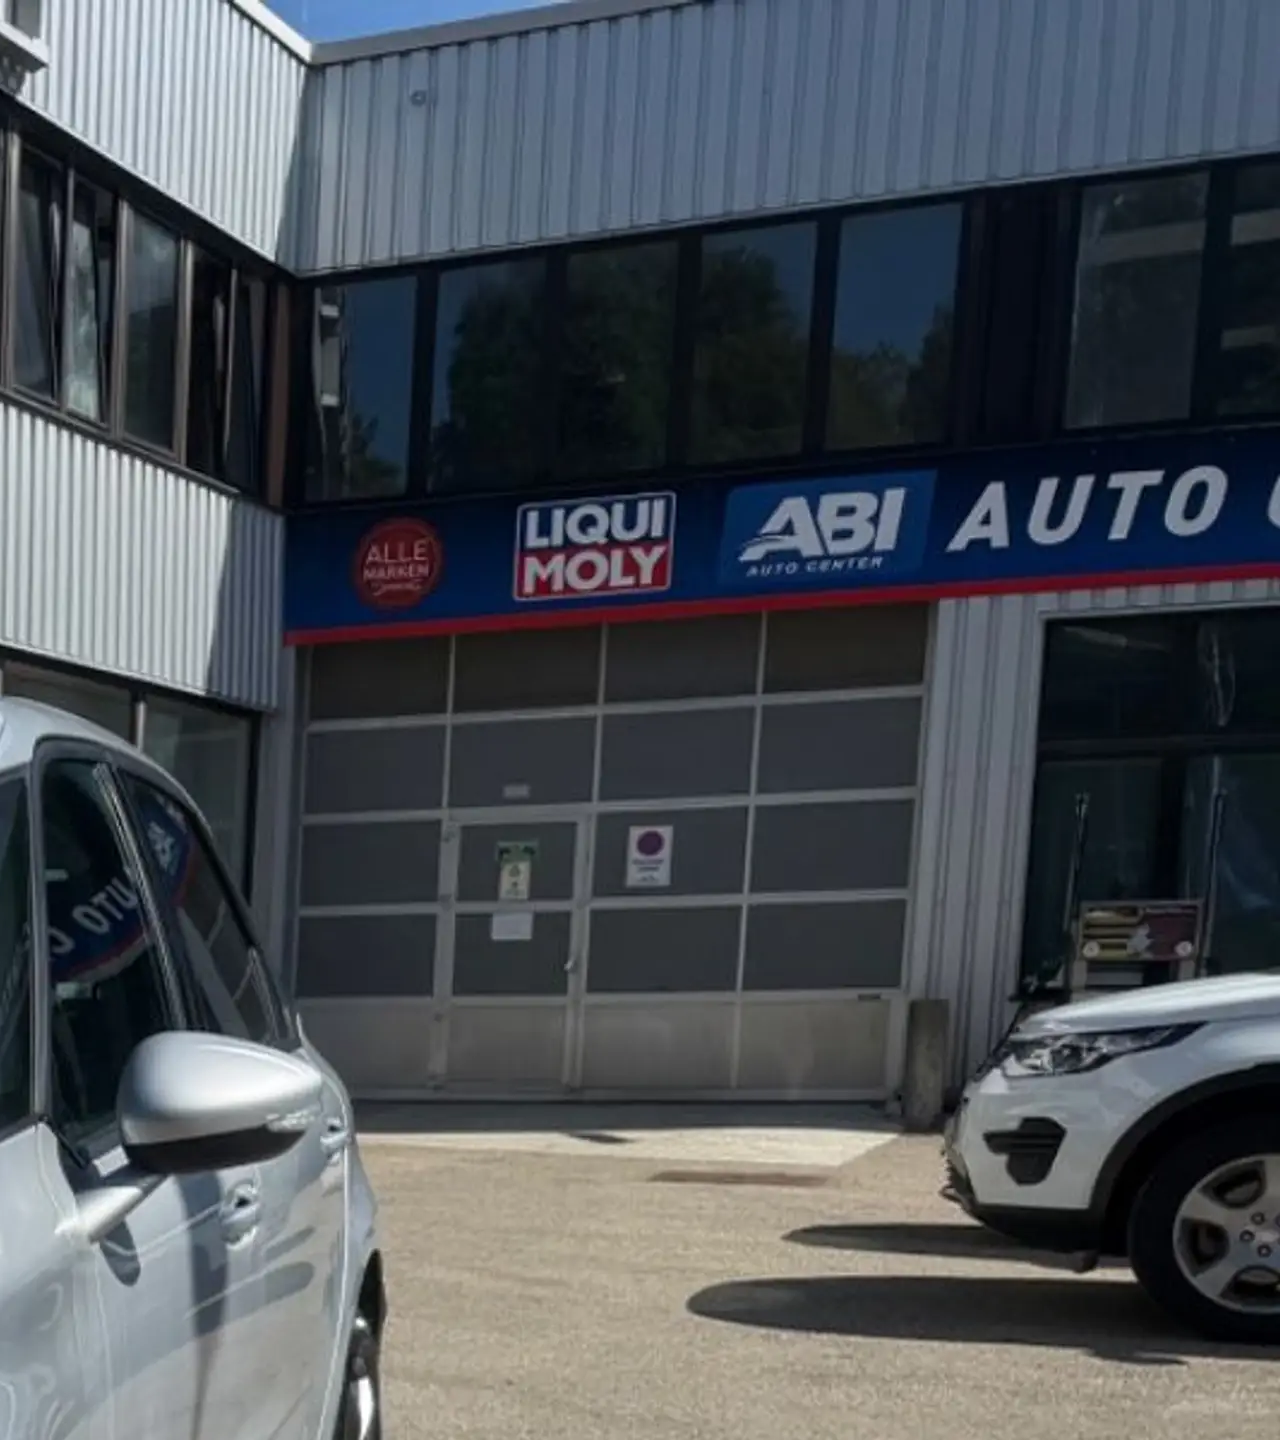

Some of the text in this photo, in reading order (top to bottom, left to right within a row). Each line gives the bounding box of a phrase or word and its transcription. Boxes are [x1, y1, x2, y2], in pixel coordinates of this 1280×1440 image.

[525, 499, 665, 549] LIQUI
[738, 487, 906, 562] ABI
[945, 465, 1228, 552] AUTO
[363, 563, 429, 581] MARKEN
[367, 540, 429, 563] ALLE
[523, 545, 666, 593] MOLY
[746, 556, 884, 577] AUTO CENTER
